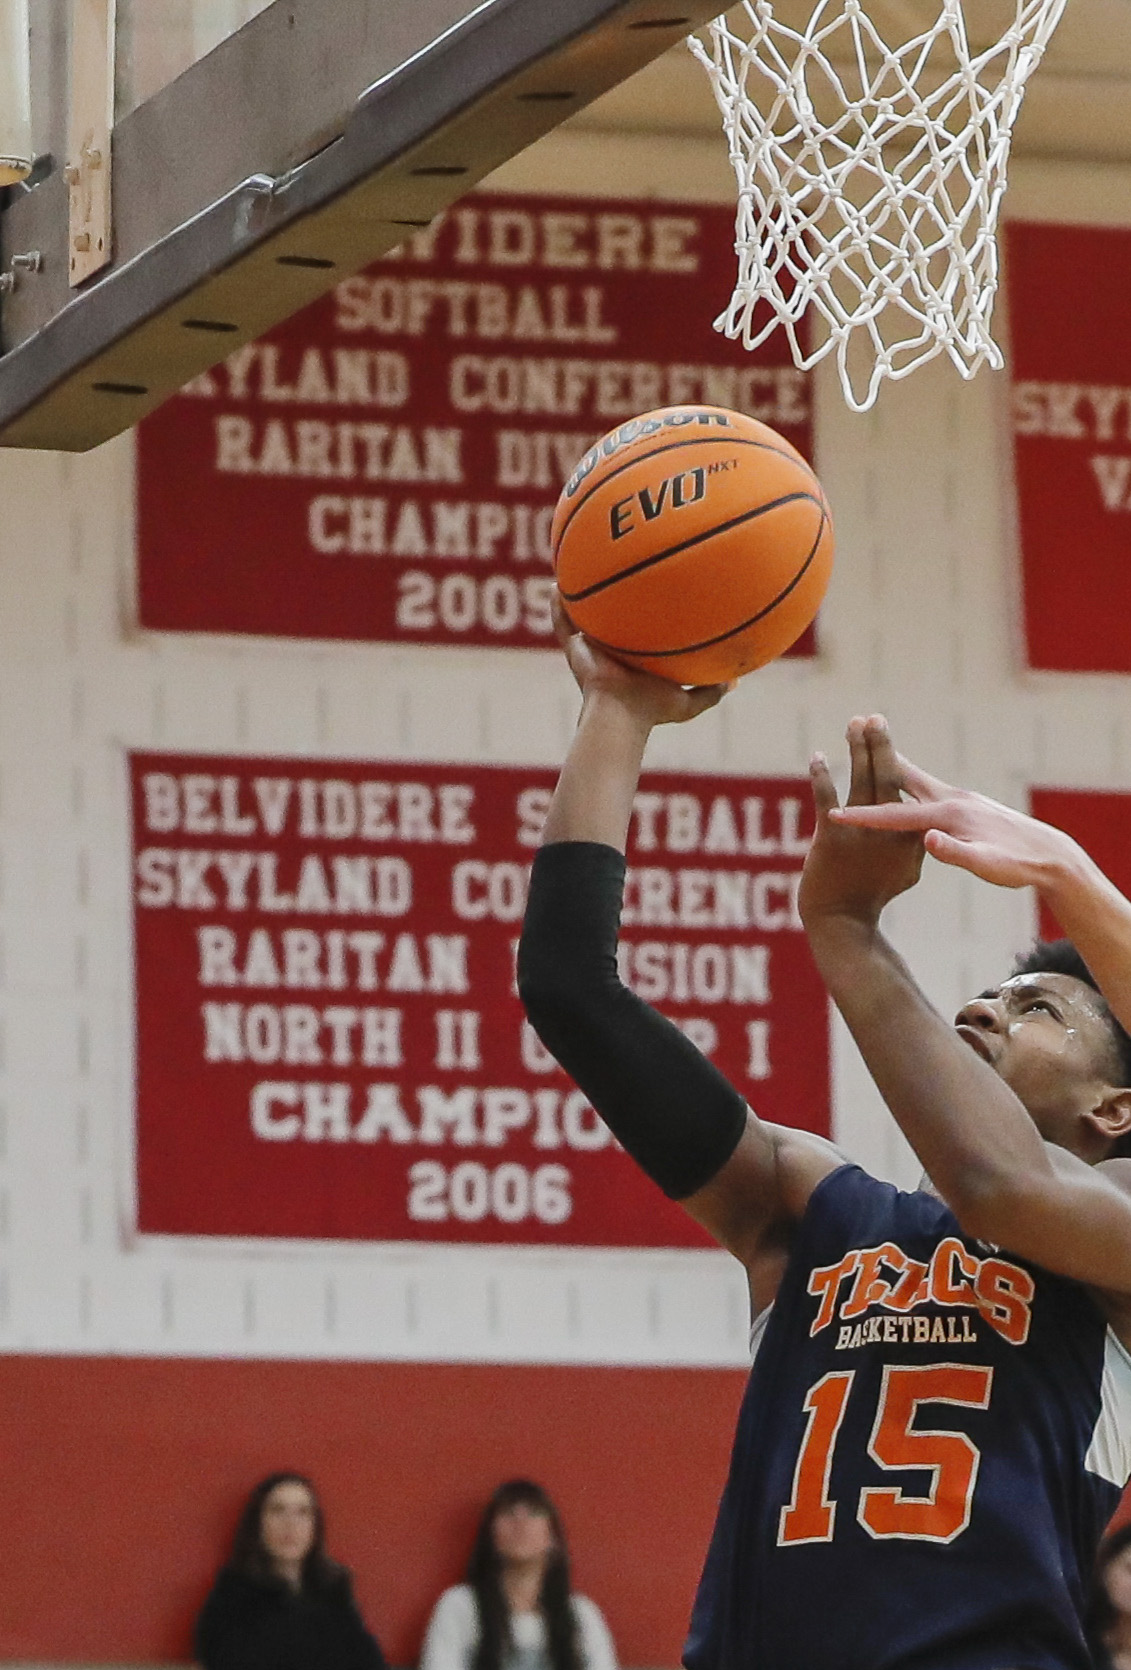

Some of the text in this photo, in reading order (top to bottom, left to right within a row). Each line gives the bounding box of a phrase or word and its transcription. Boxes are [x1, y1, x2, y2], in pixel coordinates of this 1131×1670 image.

[385, 209, 699, 272] VIDERE
[336, 275, 619, 344] SOFTBALL
[180, 345, 410, 407] YLAND
[451, 355, 811, 421] CONFERENCE
[214, 414, 463, 484] RARITAN
[308, 495, 556, 562] CHAMPI
[609, 457, 741, 540] EVO NXT
[396, 570, 557, 634] 2005
[143, 774, 812, 856] BELVIDERE STBALL
[136, 848, 805, 932] SKYLAND CORENC
[197, 926, 469, 995] RARITAN
[202, 1001, 404, 1068] NORTH
[250, 1080, 627, 1152] CHAMPIO
[407, 1160, 573, 1225] 2006
[776, 1361, 995, 1547] 15
